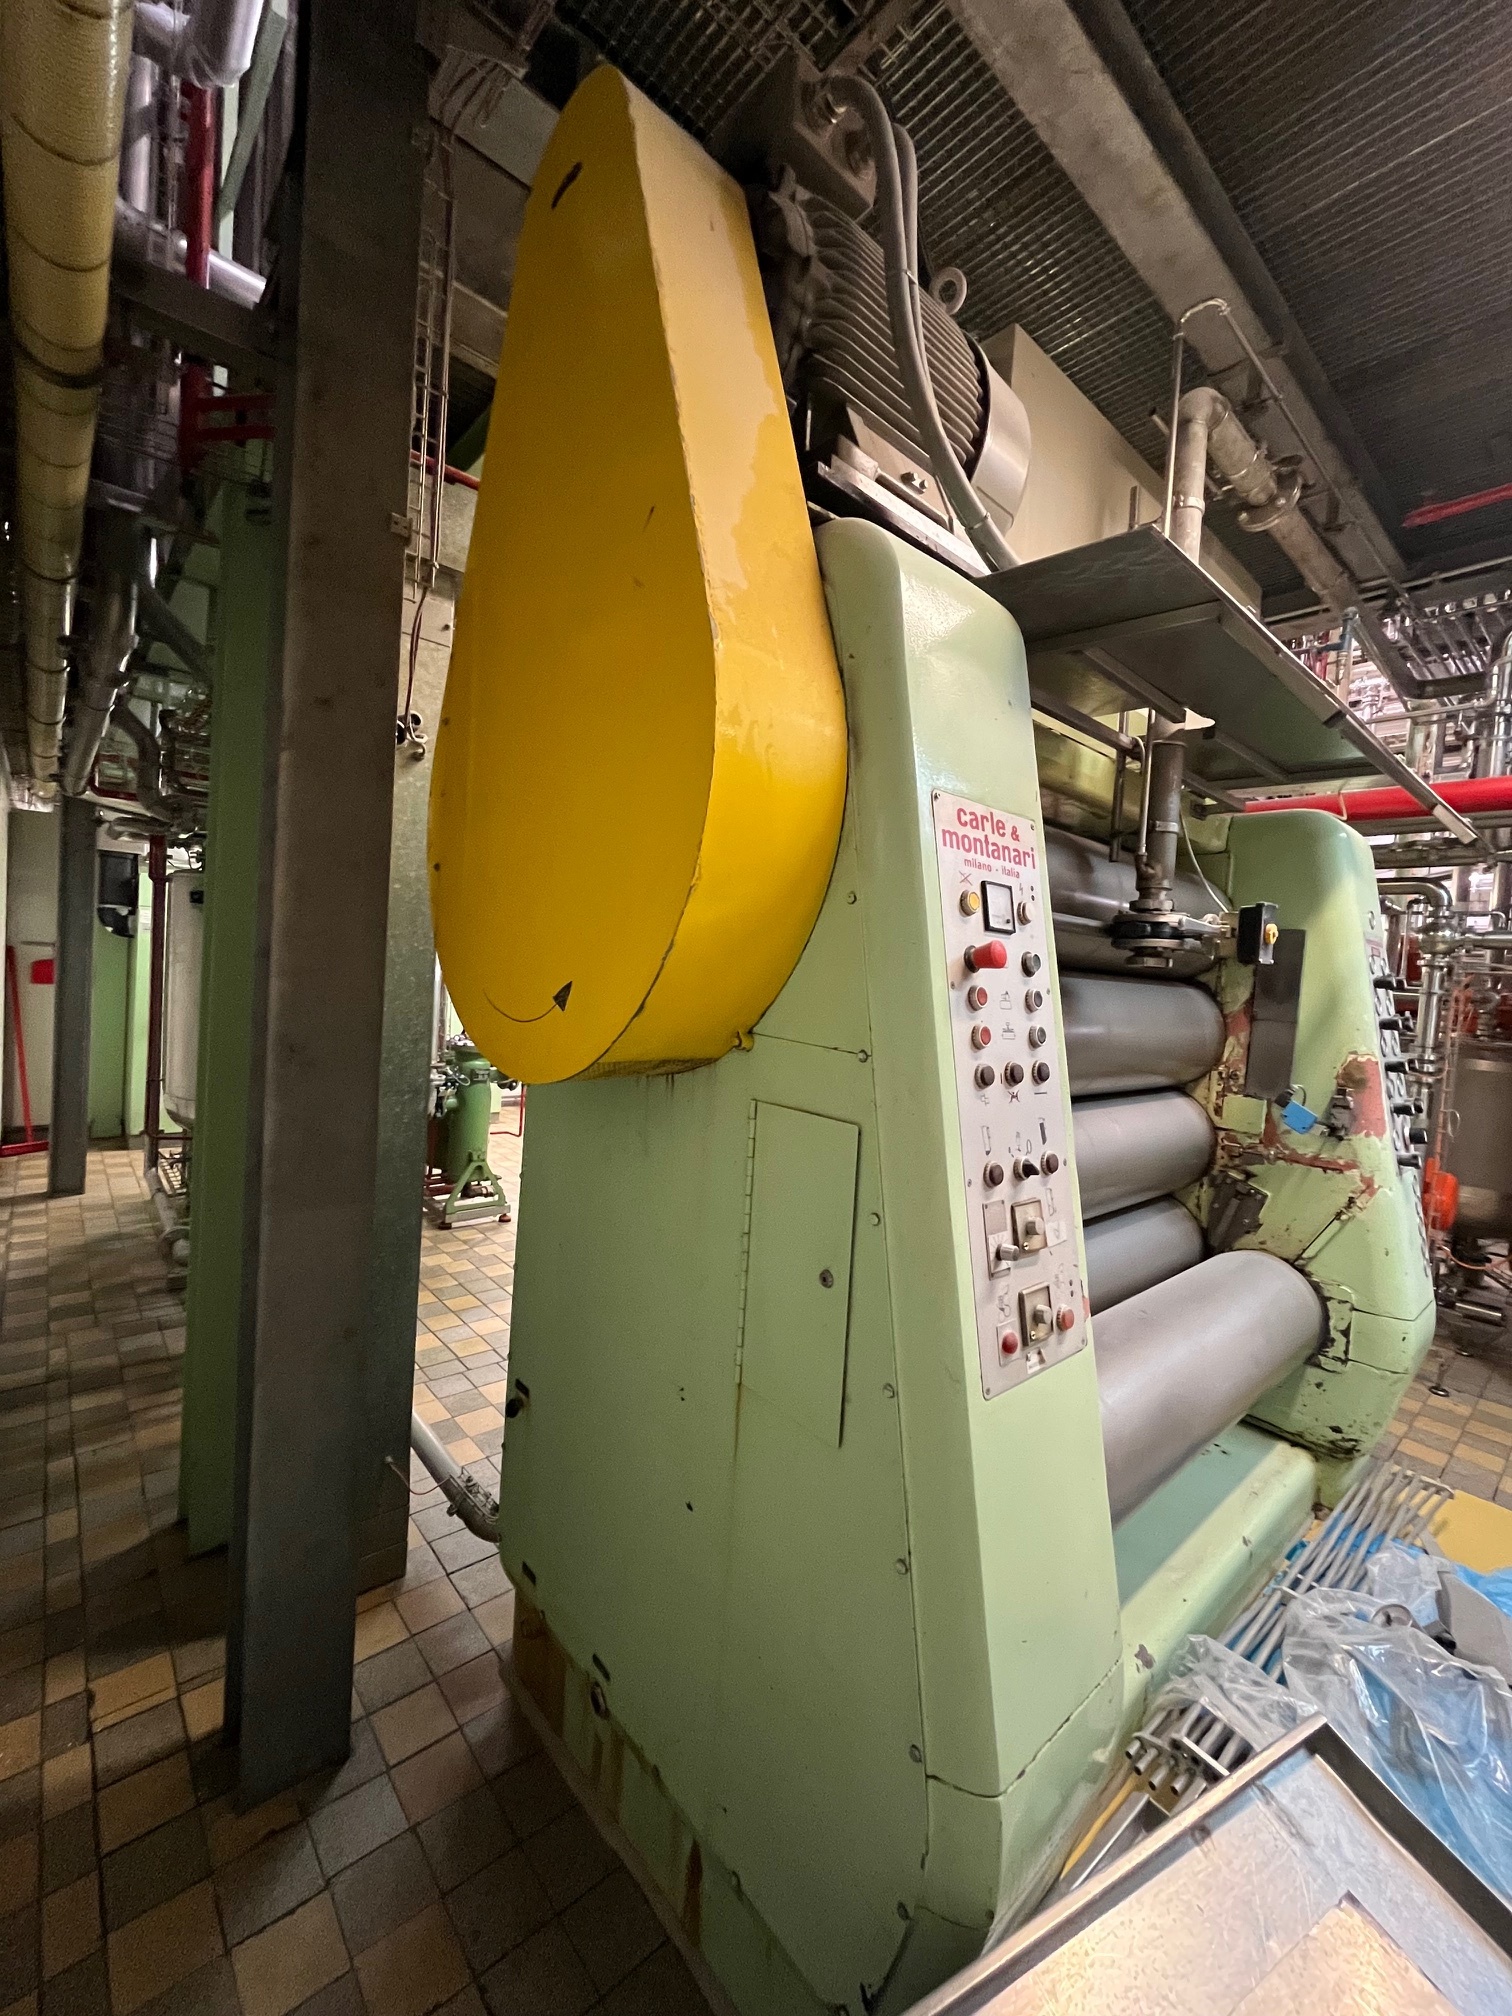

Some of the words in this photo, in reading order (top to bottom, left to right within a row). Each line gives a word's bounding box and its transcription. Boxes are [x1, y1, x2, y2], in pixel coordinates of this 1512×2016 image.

[956, 807, 1006, 838] carle
[1010, 825, 1021, 843] &
[942, 828, 1036, 870] montanari
[964, 858, 992, 872] milano
[1001, 864, 1020, 879] italia
